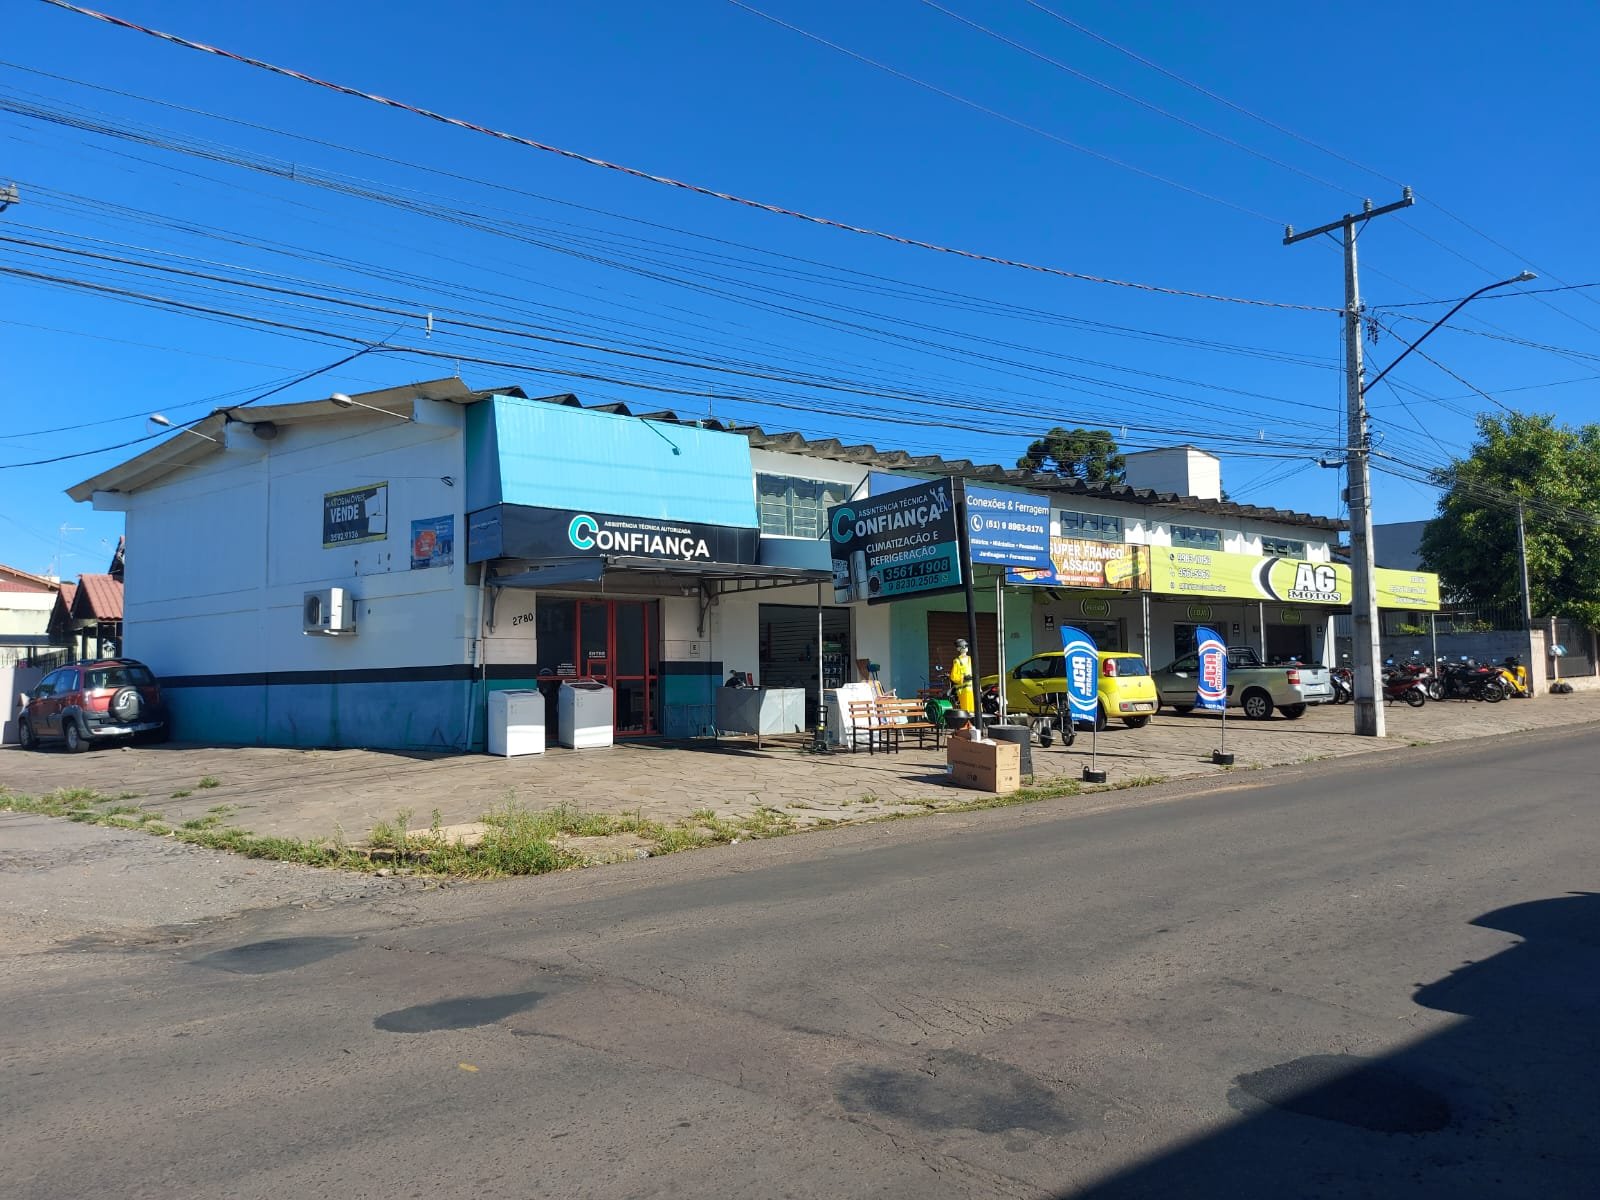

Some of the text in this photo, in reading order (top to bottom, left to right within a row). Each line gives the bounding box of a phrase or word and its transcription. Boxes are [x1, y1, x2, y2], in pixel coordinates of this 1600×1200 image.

[899, 495, 928, 508] TÉCNICA
[967, 495, 1006, 510] Conexões
[1015, 501, 1049, 516] Ferragem
[330, 504, 359, 523] VENDE
[832, 503, 941, 544] CONFIANÇA
[568, 515, 710, 560] CONFIANÇA
[866, 530, 940, 554] CLIMATIZAÇÃO E
[870, 545, 937, 567] REFRIGERAÇÃO
[1050, 543, 1124, 560] SUPER FRANGO
[885, 559, 949, 581] 3561.1908
[1062, 560, 1103, 572] ASSADO
[1294, 562, 1337, 593] AG
[1288, 589, 1341, 602] MOTOS
[512, 612, 534, 626] 2780
[1071, 656, 1086, 696] JCA
[1203, 653, 1217, 688] JCA
